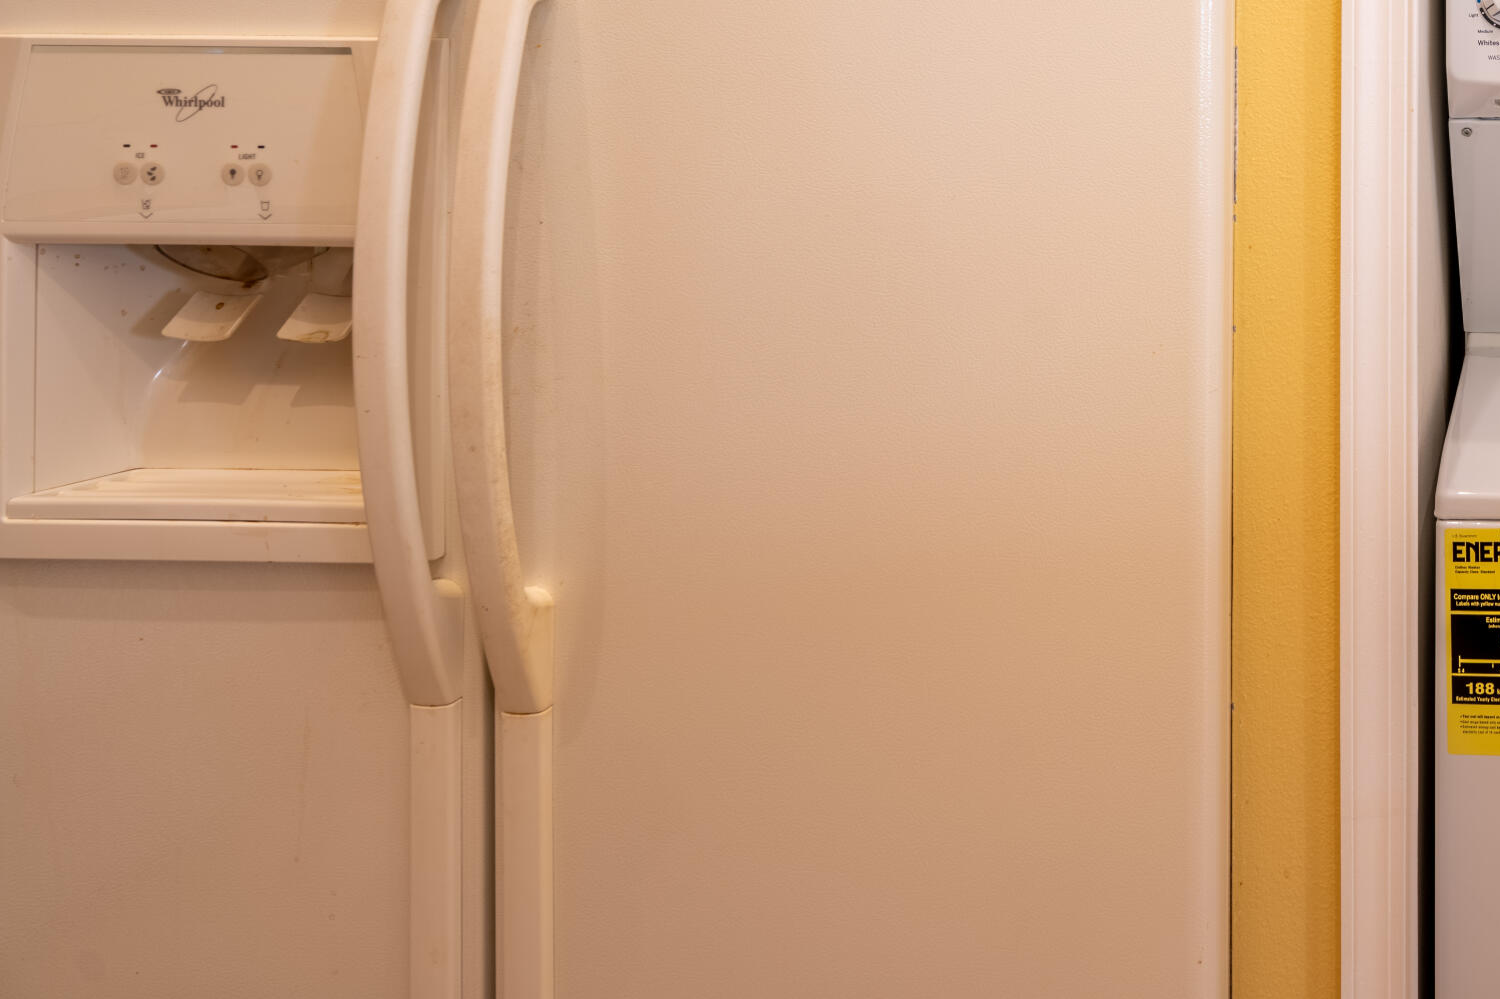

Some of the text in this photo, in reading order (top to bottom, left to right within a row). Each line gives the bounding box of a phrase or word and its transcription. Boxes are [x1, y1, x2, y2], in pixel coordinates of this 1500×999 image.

[161, 95, 225, 111] Whirlpool
[1453, 593, 1479, 602] Compare
[1465, 682, 1495, 695] 188
